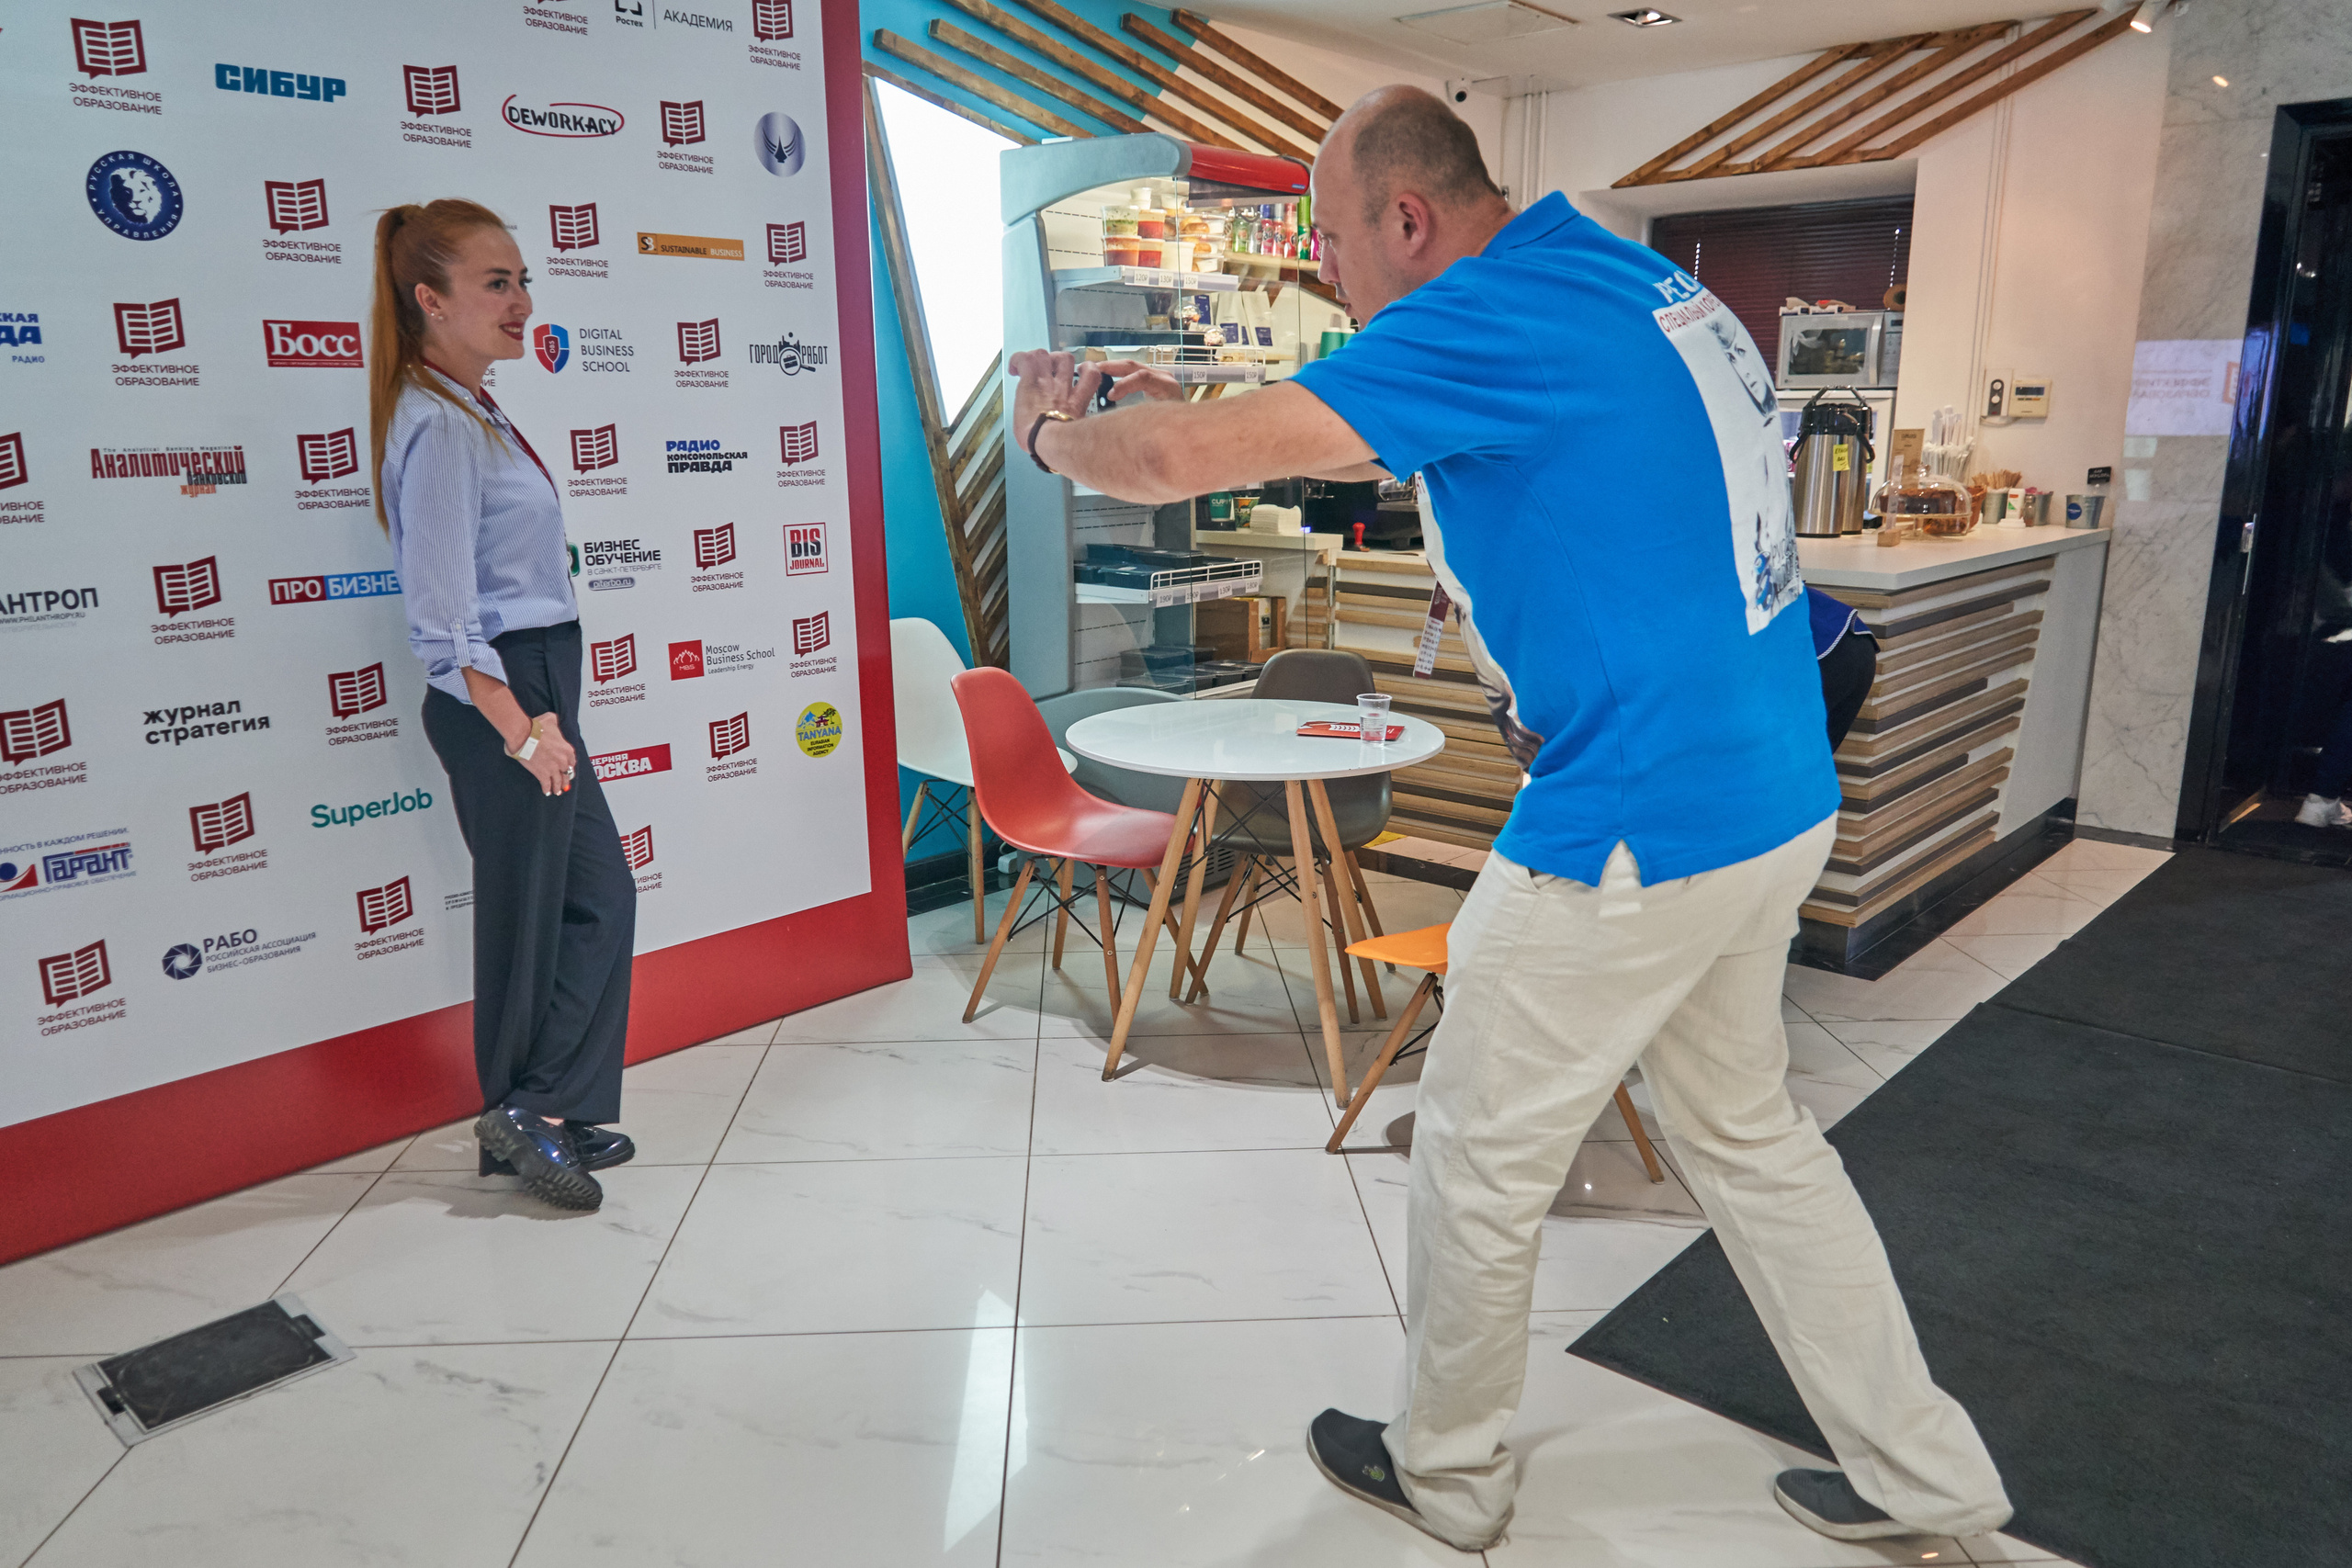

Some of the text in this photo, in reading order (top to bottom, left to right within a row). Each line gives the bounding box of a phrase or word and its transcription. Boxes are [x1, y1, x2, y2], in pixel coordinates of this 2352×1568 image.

[523, 6, 588, 25] ЭФФЕКТИВНОЕ
[616, 16, 643, 28] Ростех
[663, 9, 733, 32] АКАДЕМИЯ
[526, 17, 588, 36] ОБРАЗОВАНИЕ
[748, 45, 801, 62] ЭФФЕКТИВНОЕ
[750, 56, 801, 71] ОБРАЗОВАНИЕ
[214, 62, 346, 103] СИБУР
[69, 83, 162, 102] ЭФФЕКТИВНОЕ
[73, 96, 162, 116] ОБРАЗОВАНИЕ
[508, 106, 616, 135] DEWORKACY
[400, 121, 471, 138] ЭФФЕКТИВНОЕ
[402, 133, 471, 149] ОБРАЗОВАНИЕ
[657, 151, 714, 165] ЭФФЕКТИВНОЕ
[88, 153, 179, 197] РУССКАЯ ШКОЛА
[659, 162, 714, 175] ОБРАЗОВАНИЕ
[97, 209, 178, 239] УПРАВЛЕНИЯ
[262, 239, 342, 254] ЭФФЕКТИВНОЕ
[661, 244, 742, 257] SUSTAINABLE BUSINESS
[265, 252, 342, 265] ОБРАЗОВАНИЕ
[546, 256, 608, 268] ЭФФЕКТИВНОЕ
[548, 267, 608, 279] ОБРАЗОВАНИЕ
[763, 270, 814, 281] ЭФФЕКТИВНОЕ
[764, 279, 813, 290] ОБРАЗОВАНИЕ
[579, 328, 623, 340] DIGITAL
[581, 344, 634, 356] BUSINESS
[749, 344, 828, 365] ГОРОД РАБОТ
[12, 355, 45, 364] РАДИО
[582, 361, 630, 372] SCHOOL
[111, 365, 199, 375] ЭФФЕКТИВНОЕ
[673, 370, 729, 379] ЭФФЕКТИВНОЕ
[115, 375, 199, 387] ОБРАЗОВАНИЕ
[675, 378, 729, 389] ОБРАЗОВАНИЕ
[666, 440, 720, 453] РАДИО
[90, 446, 246, 479] Аналитический
[667, 452, 748, 461] КОМСОМОЛЬСКАЯ
[668, 460, 732, 473] ПРАВДА
[776, 469, 826, 479] ЭФФЕКТИВНОЕ
[567, 478, 628, 488] ЭФФЕКТИВНОЕ
[778, 479, 825, 488] ОБРАЗОВАНИЕ
[295, 487, 370, 499] ЭФФЕКТИВНОЕ
[569, 488, 628, 497] ОБРАЗОВАНИЕ
[0, 501, 44, 511] ИВНОЕ
[298, 499, 370, 510] ОБРАЗОВАНИЕ
[583, 539, 640, 553] БИЗНЕС
[789, 528, 821, 558] BIS
[585, 550, 662, 566] ОБУЧЕНИЕ
[789, 558, 824, 570] JOURNAL
[593, 578, 631, 589] piterbo.ru
[691, 571, 743, 583] ЭФФЕКТИВНОЕ
[328, 573, 399, 597] БИЗНЕ
[692, 581, 743, 592] ОБРАЗОВАНИЕ
[151, 617, 235, 634] ЭФФЕКТИВНОЕ
[154, 629, 235, 645] ОБРАЗОВАНИЕ
[706, 644, 740, 655] Moscow
[707, 648, 775, 665] Business School
[708, 662, 754, 674] Leadership Energy
[789, 657, 837, 669] ЭФФЕКТИВНОЕ
[790, 666, 837, 678] ОБРАЗОВАНИЕ
[588, 682, 646, 699] ЭФФЕКТИВНОЕ
[589, 694, 646, 707] ОБРАЗОВАНИЕ
[142, 700, 242, 726] журнал
[145, 716, 270, 746] стратегия
[325, 717, 399, 736] ЭФФЕКТИВНОЕ
[797, 726, 842, 741] TANYANA
[328, 728, 399, 746] ОБРАЗОВАНИЕ
[807, 743, 833, 751] INFORMATION
[706, 758, 758, 773] ЭФФЕКТИВНОЕ
[707, 767, 758, 783] ОБРАЗОВАНИЕ
[0, 773, 87, 795] ОБРАЗОВАНИЕ
[310, 787, 434, 829] SuperJob
[44, 835, 85, 847] КАЖДОМ
[187, 849, 267, 872] ЭФФЕКТИВНОЕ
[190, 861, 267, 882] ОБРАЗОВАНИЕ
[637, 882, 662, 893] ВАНИЕ
[203, 929, 257, 953] РАБО
[205, 931, 317, 963] РОССИЙСКАЯ АССОЦИАЦИЯ
[355, 928, 424, 951] ЭФФЕКТИВНОЕ
[356, 939, 424, 961] ОБРАЗОВАНИЕ
[207, 945, 301, 974] БИЗНЕС-ОБРАЗОВАНИЯ
[37, 998, 127, 1025] ЭФФЕКТИВНОЕ
[40, 1010, 127, 1036] ОБРАЗОВАНИЕ
